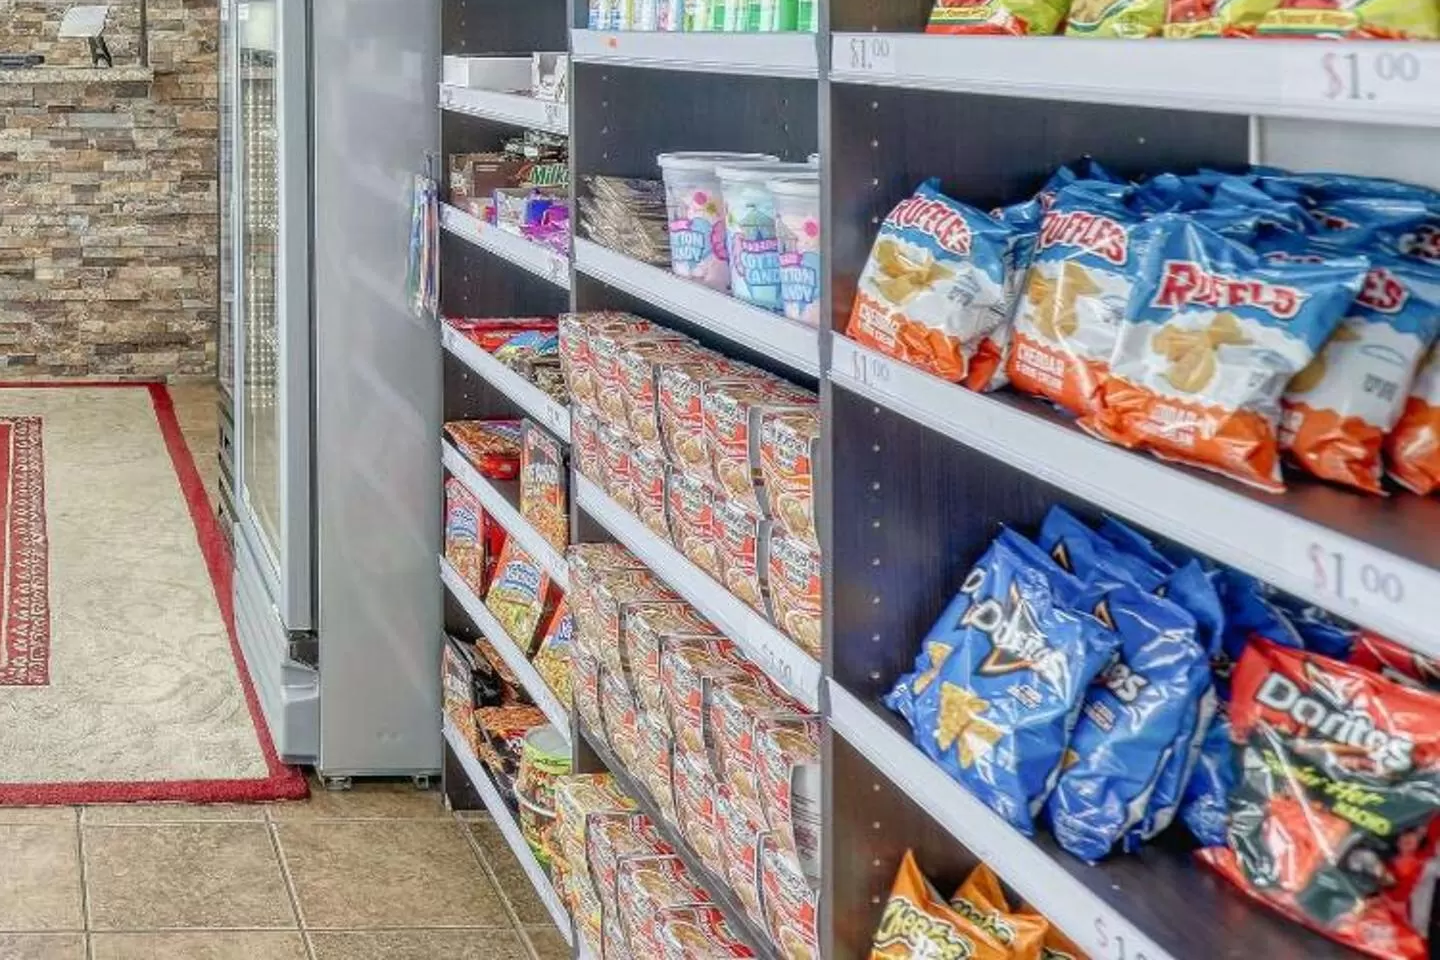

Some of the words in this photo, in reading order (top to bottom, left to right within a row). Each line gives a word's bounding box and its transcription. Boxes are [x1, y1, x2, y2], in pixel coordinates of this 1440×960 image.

[850, 37, 890, 69] $1.00
[1322, 52, 1421, 100] $1.00
[1307, 542, 1405, 608] $1.00
[1256, 672, 1415, 772] Doritos
